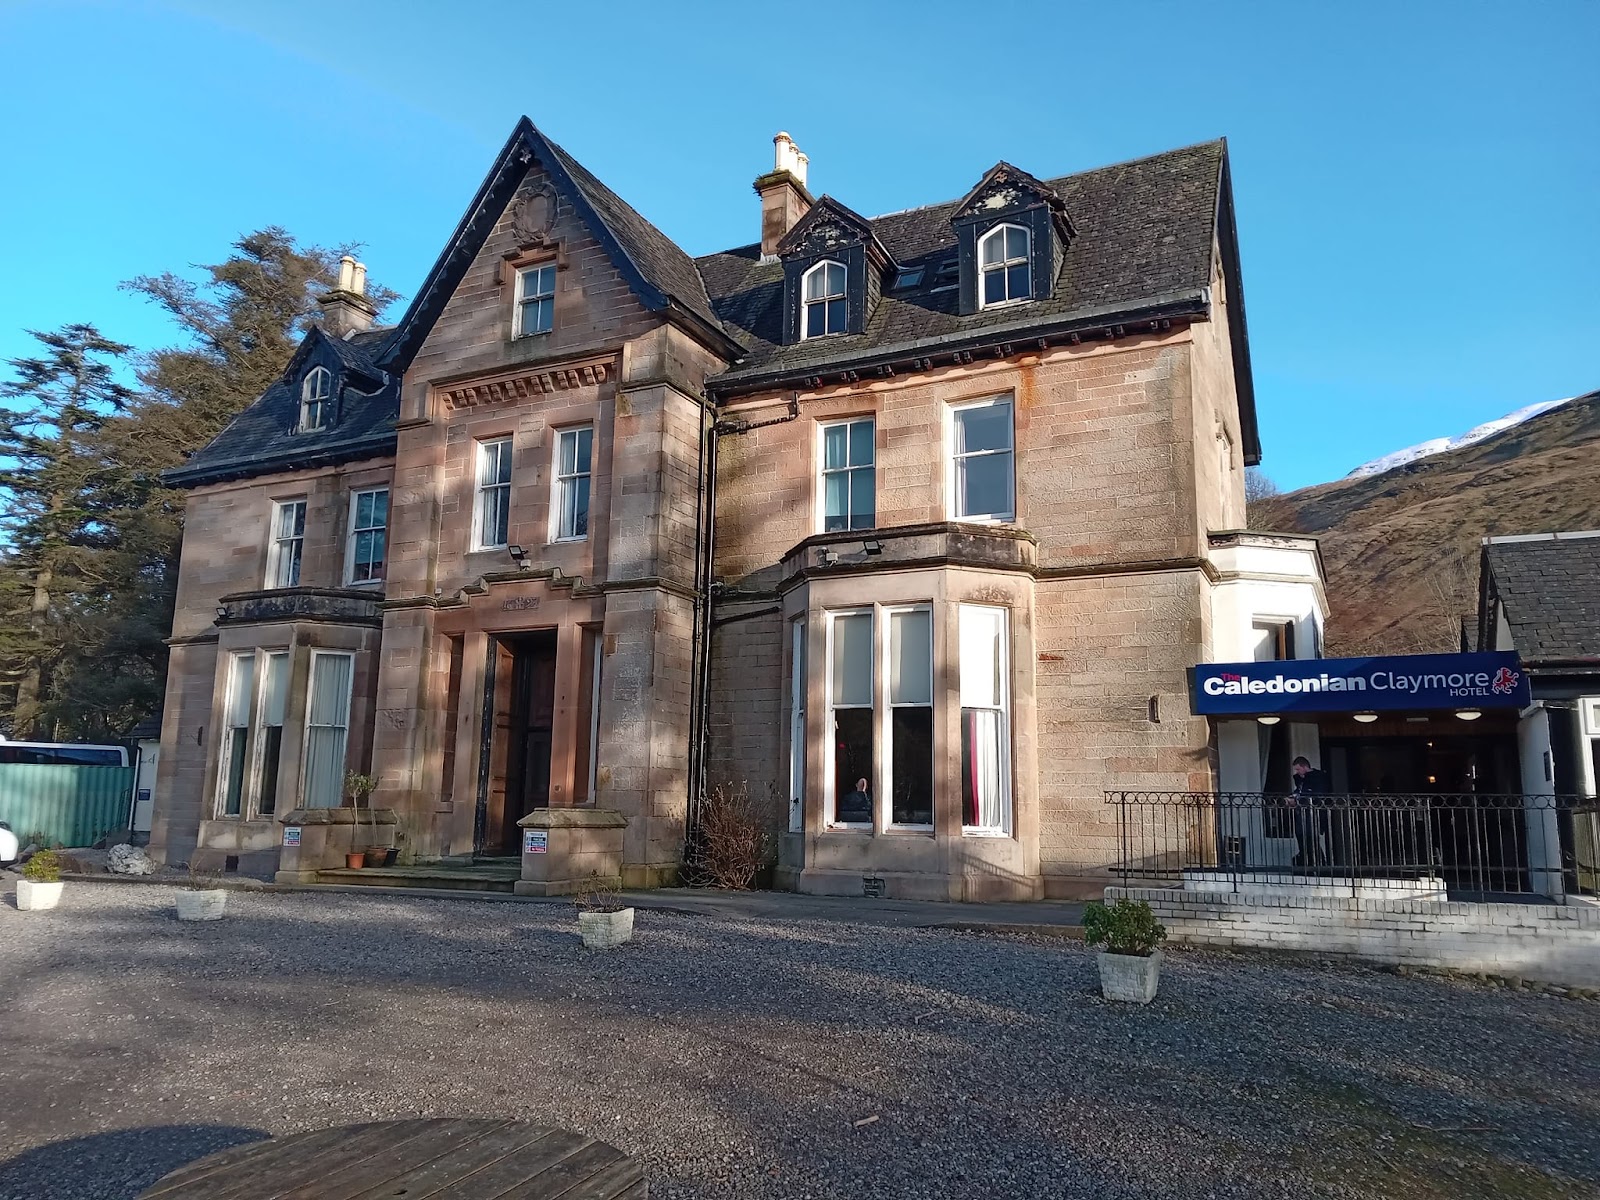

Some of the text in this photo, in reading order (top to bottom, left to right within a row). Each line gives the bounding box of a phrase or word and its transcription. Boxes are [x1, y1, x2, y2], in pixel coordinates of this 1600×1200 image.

[1221, 673, 1240, 681] The
[1204, 671, 1489, 696] Caledonian Claymore
[1450, 687, 1490, 696] HOTEL
